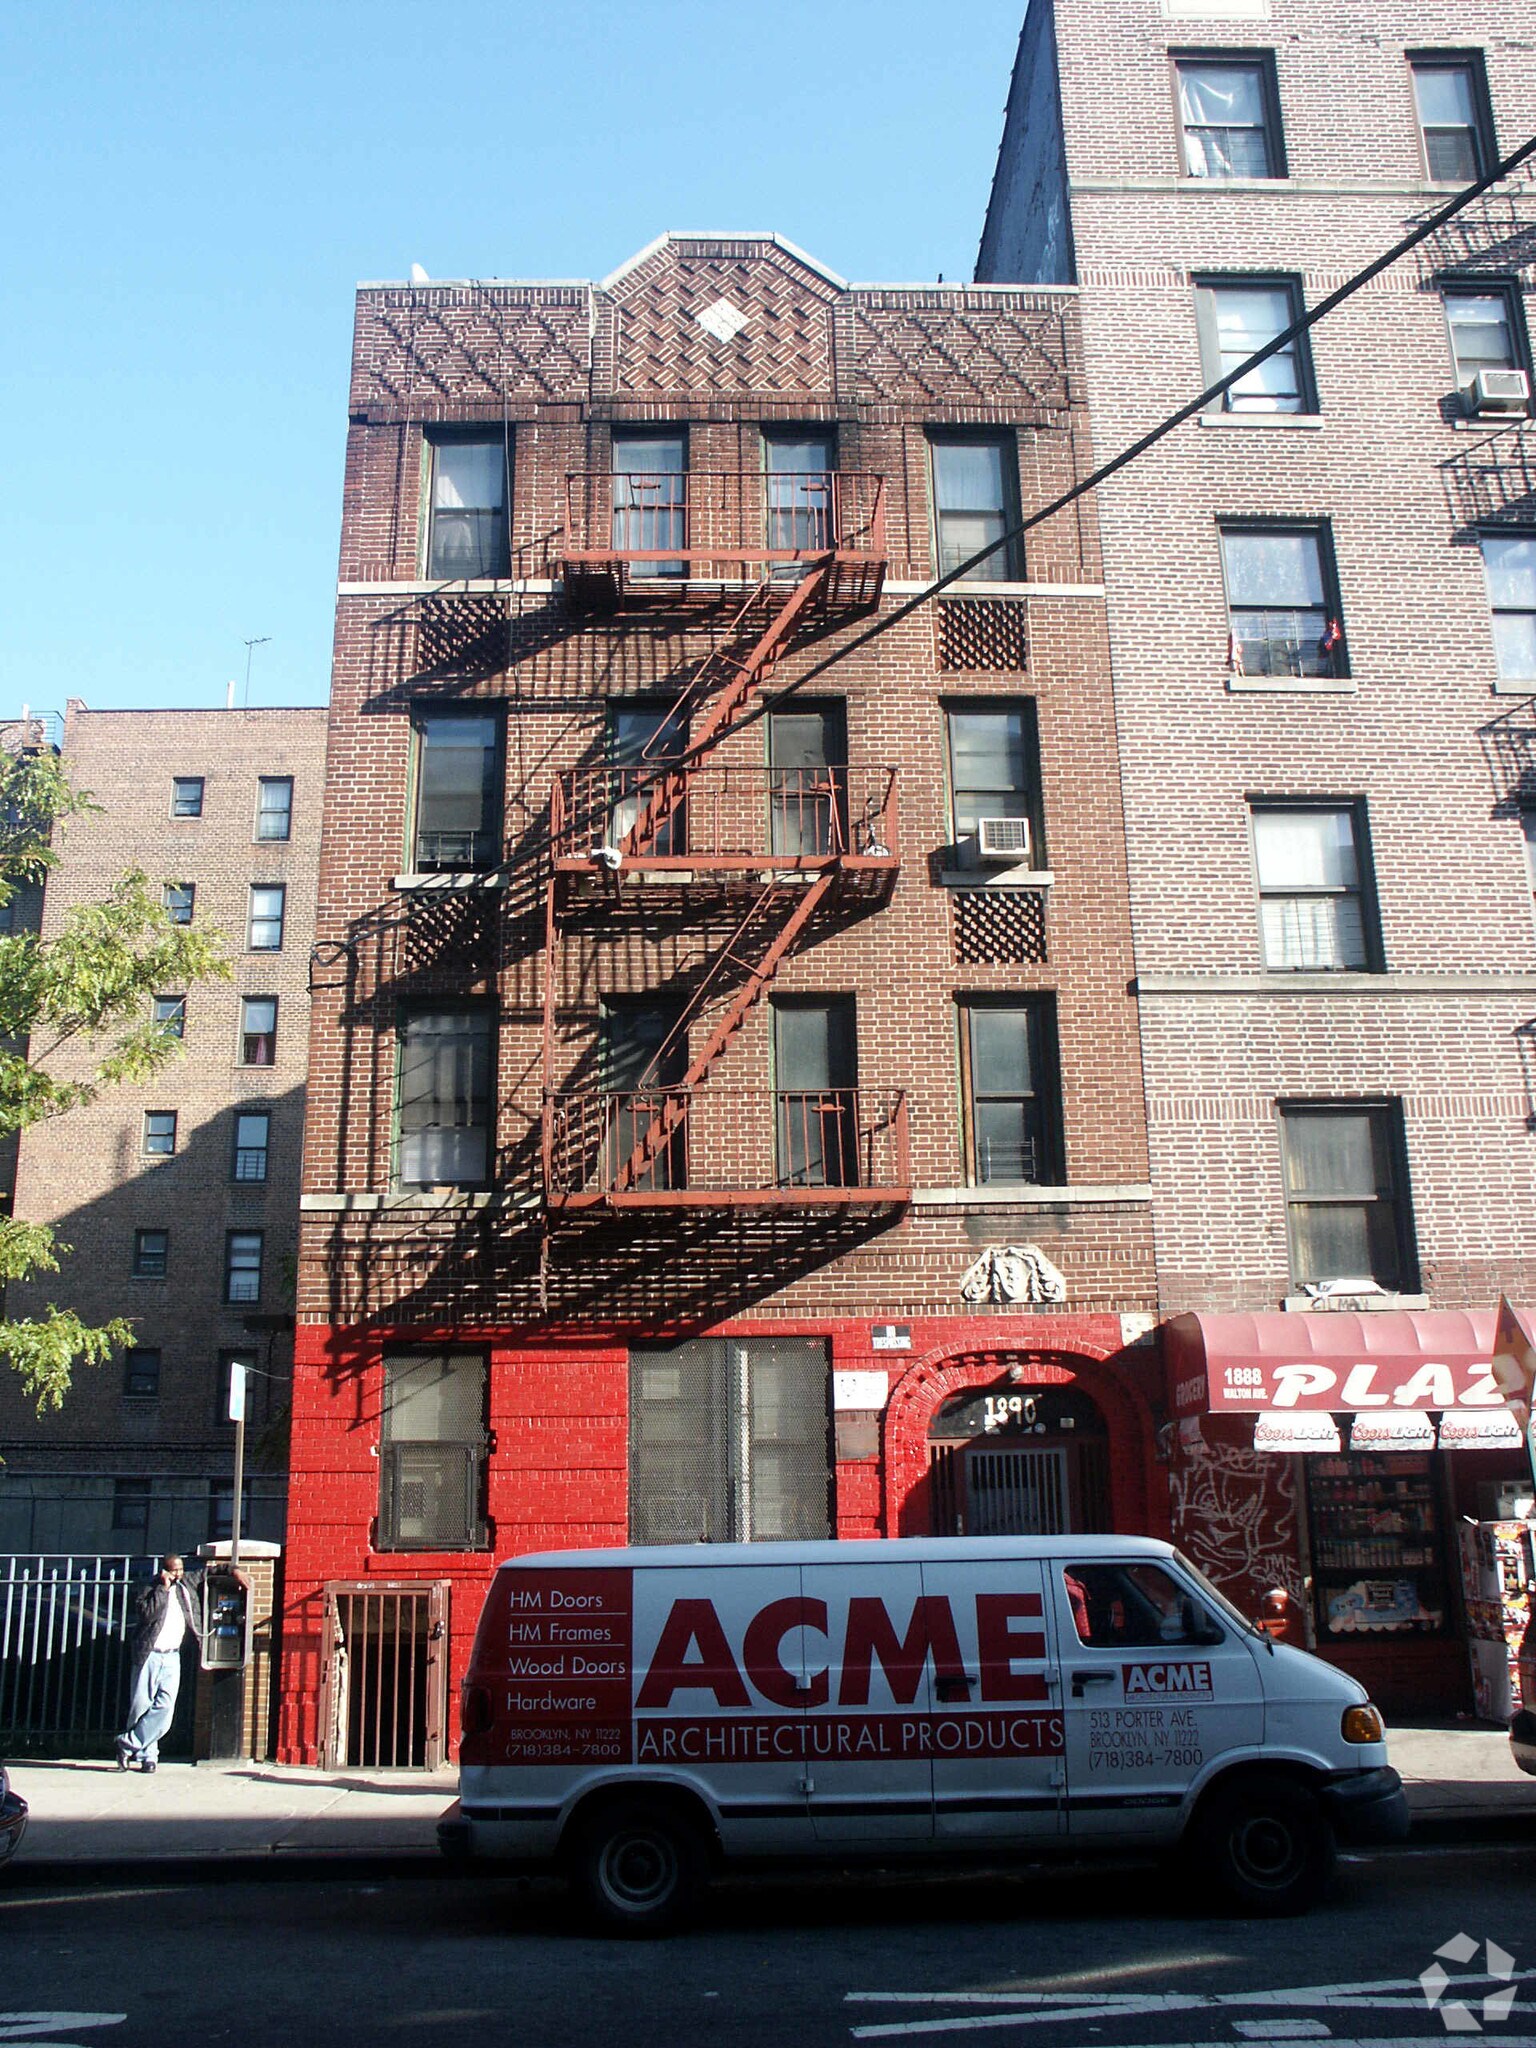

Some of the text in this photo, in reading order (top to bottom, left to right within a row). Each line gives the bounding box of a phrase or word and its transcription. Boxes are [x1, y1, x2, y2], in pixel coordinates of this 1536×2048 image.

[1224, 1367, 1263, 1385] 1888
[1271, 1363, 1536, 1406] PLAZ
[984, 1396, 1037, 1425] 1890
[1255, 1422, 1295, 1441] Coors
[1352, 1422, 1392, 1441] Coors
[1440, 1421, 1479, 1440] Coors
[510, 1590, 603, 1608] HM Doors
[509, 1622, 612, 1641] HM Frames
[634, 1593, 1049, 1709] ACME
[509, 1655, 626, 1675] Wood Doors
[1127, 1664, 1210, 1692] ACME
[507, 1690, 597, 1711] Hardware
[1090, 1709, 1198, 1729] 513 PORTER AVE.
[575, 1729, 591, 1739] NY
[596, 1729, 621, 1739] 11222
[639, 1718, 1064, 1757] ARCHITECTURAL PRODUCTS
[1154, 1730, 1170, 1746] NY
[1175, 1729, 1199, 1746] 11222
[505, 1744, 621, 1758] (718)384-7800
[1088, 1749, 1203, 1771] (718)384-7800
